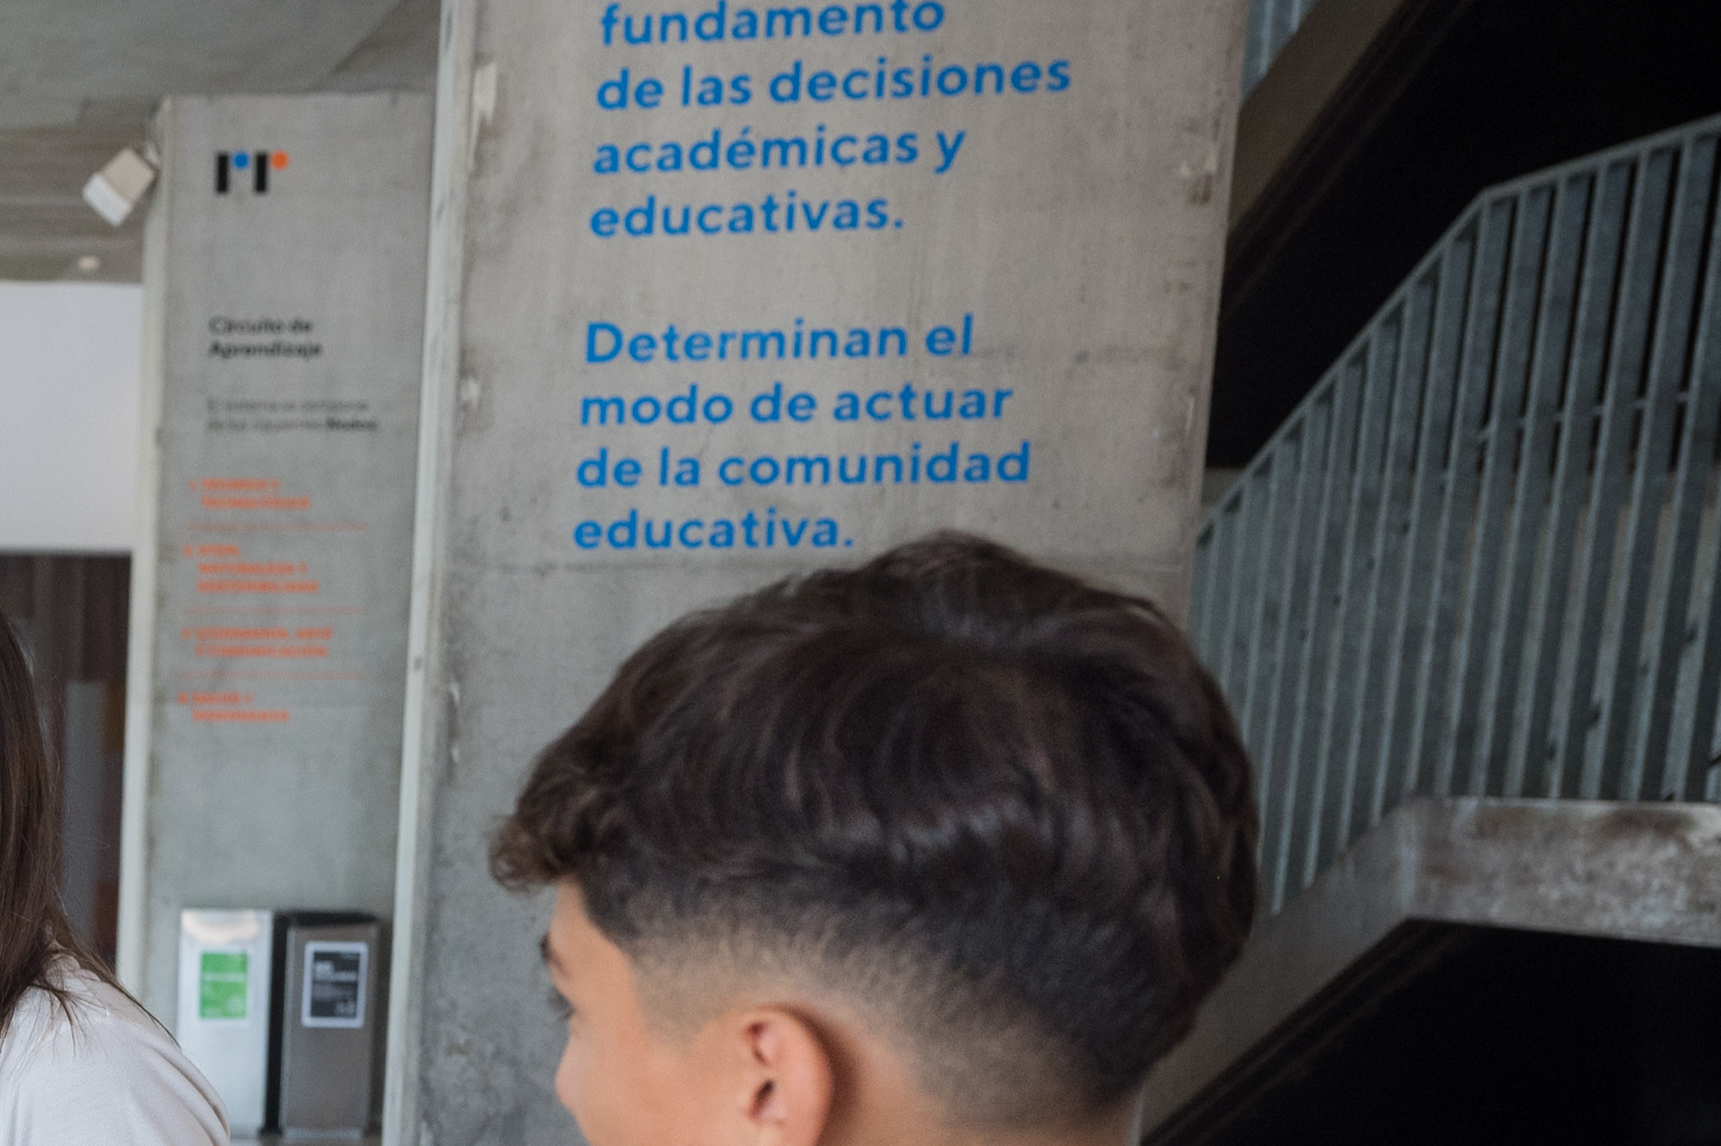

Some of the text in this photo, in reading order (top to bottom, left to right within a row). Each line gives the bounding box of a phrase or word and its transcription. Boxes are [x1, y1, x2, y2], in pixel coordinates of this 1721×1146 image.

[600, 0, 945, 46] fundamento
[595, 55, 1072, 111] de las decisiones
[592, 123, 967, 175] académicas y
[589, 189, 904, 239] educativas.
[585, 313, 974, 365] Determinan el
[579, 381, 1014, 427] modo de actuar
[575, 440, 1032, 489] de la comunidad
[572, 506, 855, 551] educativa.
